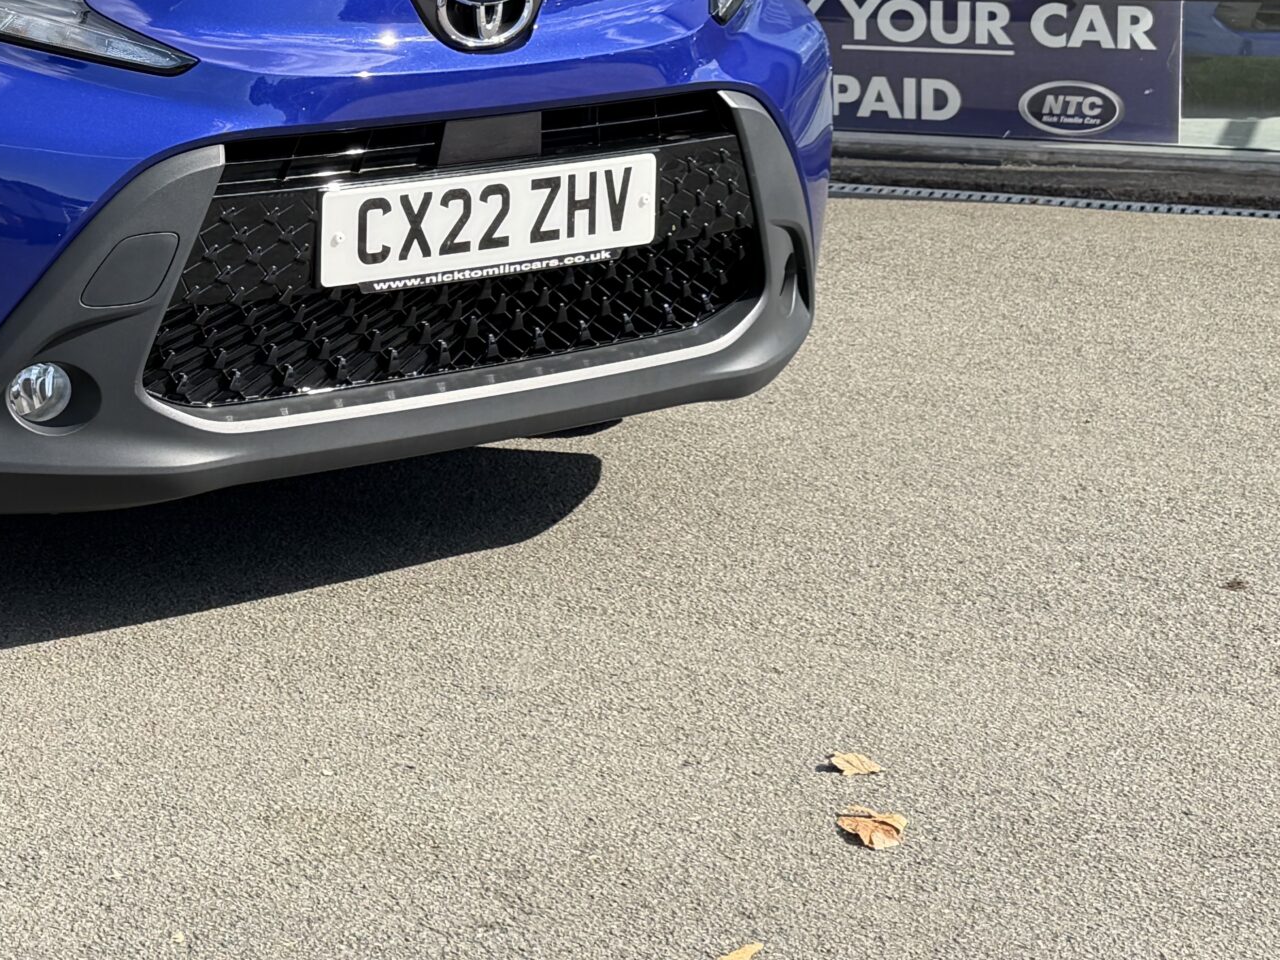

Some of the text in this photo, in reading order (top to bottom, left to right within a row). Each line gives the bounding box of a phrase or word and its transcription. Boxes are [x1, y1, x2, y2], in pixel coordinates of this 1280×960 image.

[1030, 2, 1157, 51] CAR
[832, 74, 962, 122] PAID
[1041, 94, 1104, 117] NTC
[356, 166, 633, 266] CX22 ZHV
[373, 249, 612, 292] www.nicktomlincars.co.uk
